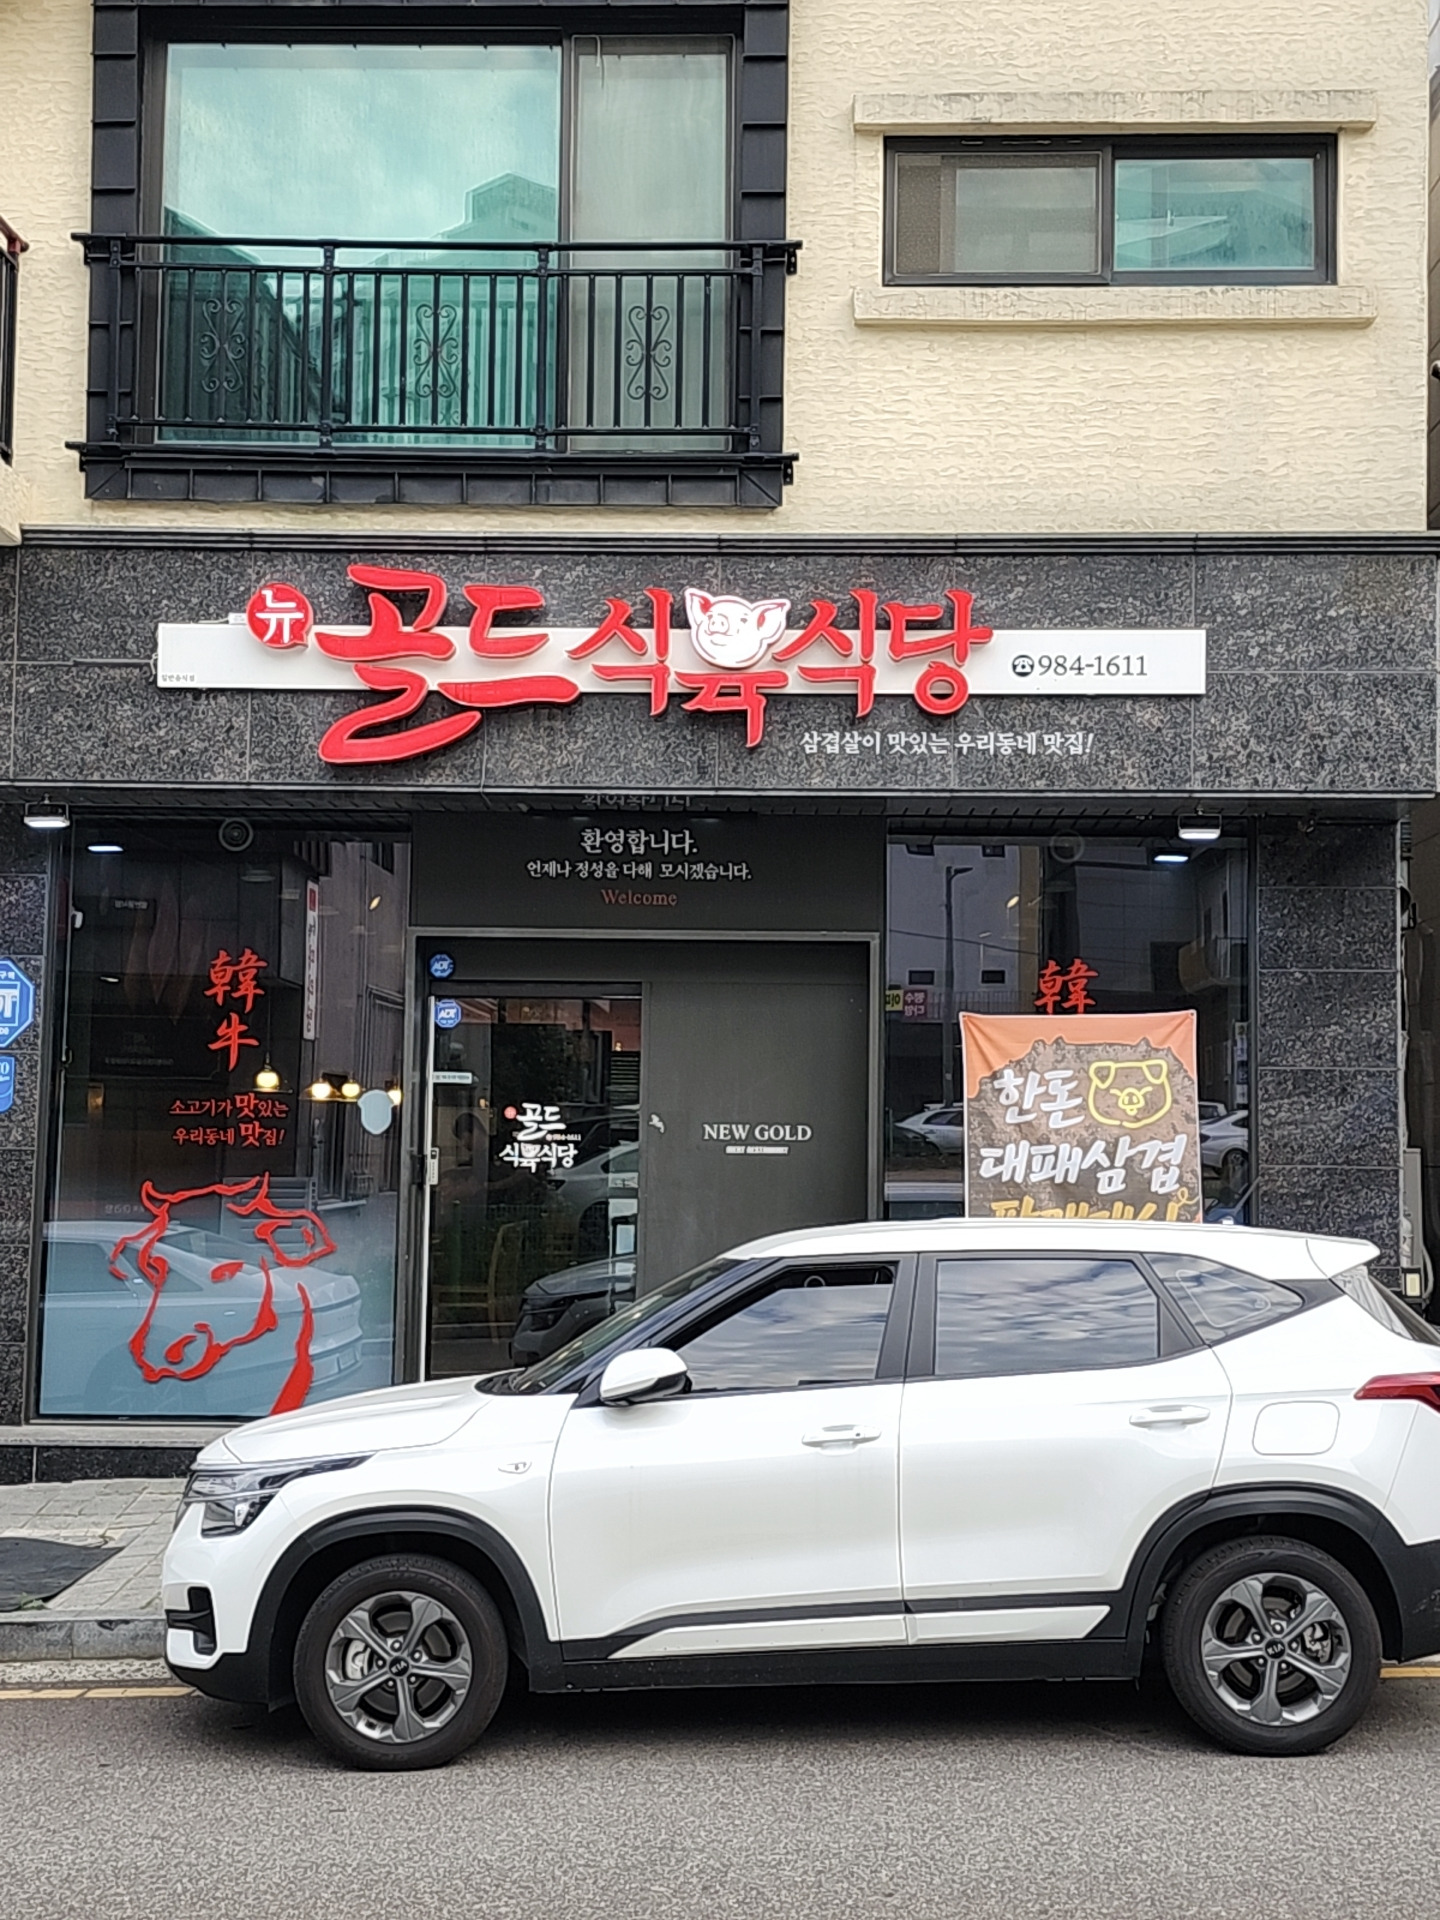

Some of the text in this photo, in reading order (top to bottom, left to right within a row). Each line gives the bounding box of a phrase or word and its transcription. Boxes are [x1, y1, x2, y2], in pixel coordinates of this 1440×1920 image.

[255, 564, 994, 763] 뉴 골드 식육식당
[1038, 654, 1148, 676] 984-1611
[800, 731, 1095, 756] 삼겹살이 맛있는 우리동네 맛집!
[580, 828, 698, 855] 환영합니다.
[527, 861, 752, 881] 언제나 정성을 다해 모시겠습니다.
[601, 889, 678, 906] Welcome
[169, 1092, 289, 1118] 소고기가 맛있는
[994, 1069, 1085, 1128] 한돈
[172, 1121, 285, 1147] 우리동네 맛집!
[516, 1102, 567, 1141] 골드
[703, 1124, 812, 1141] NEW GOLD
[979, 1134, 1187, 1194] 대패삼겹
